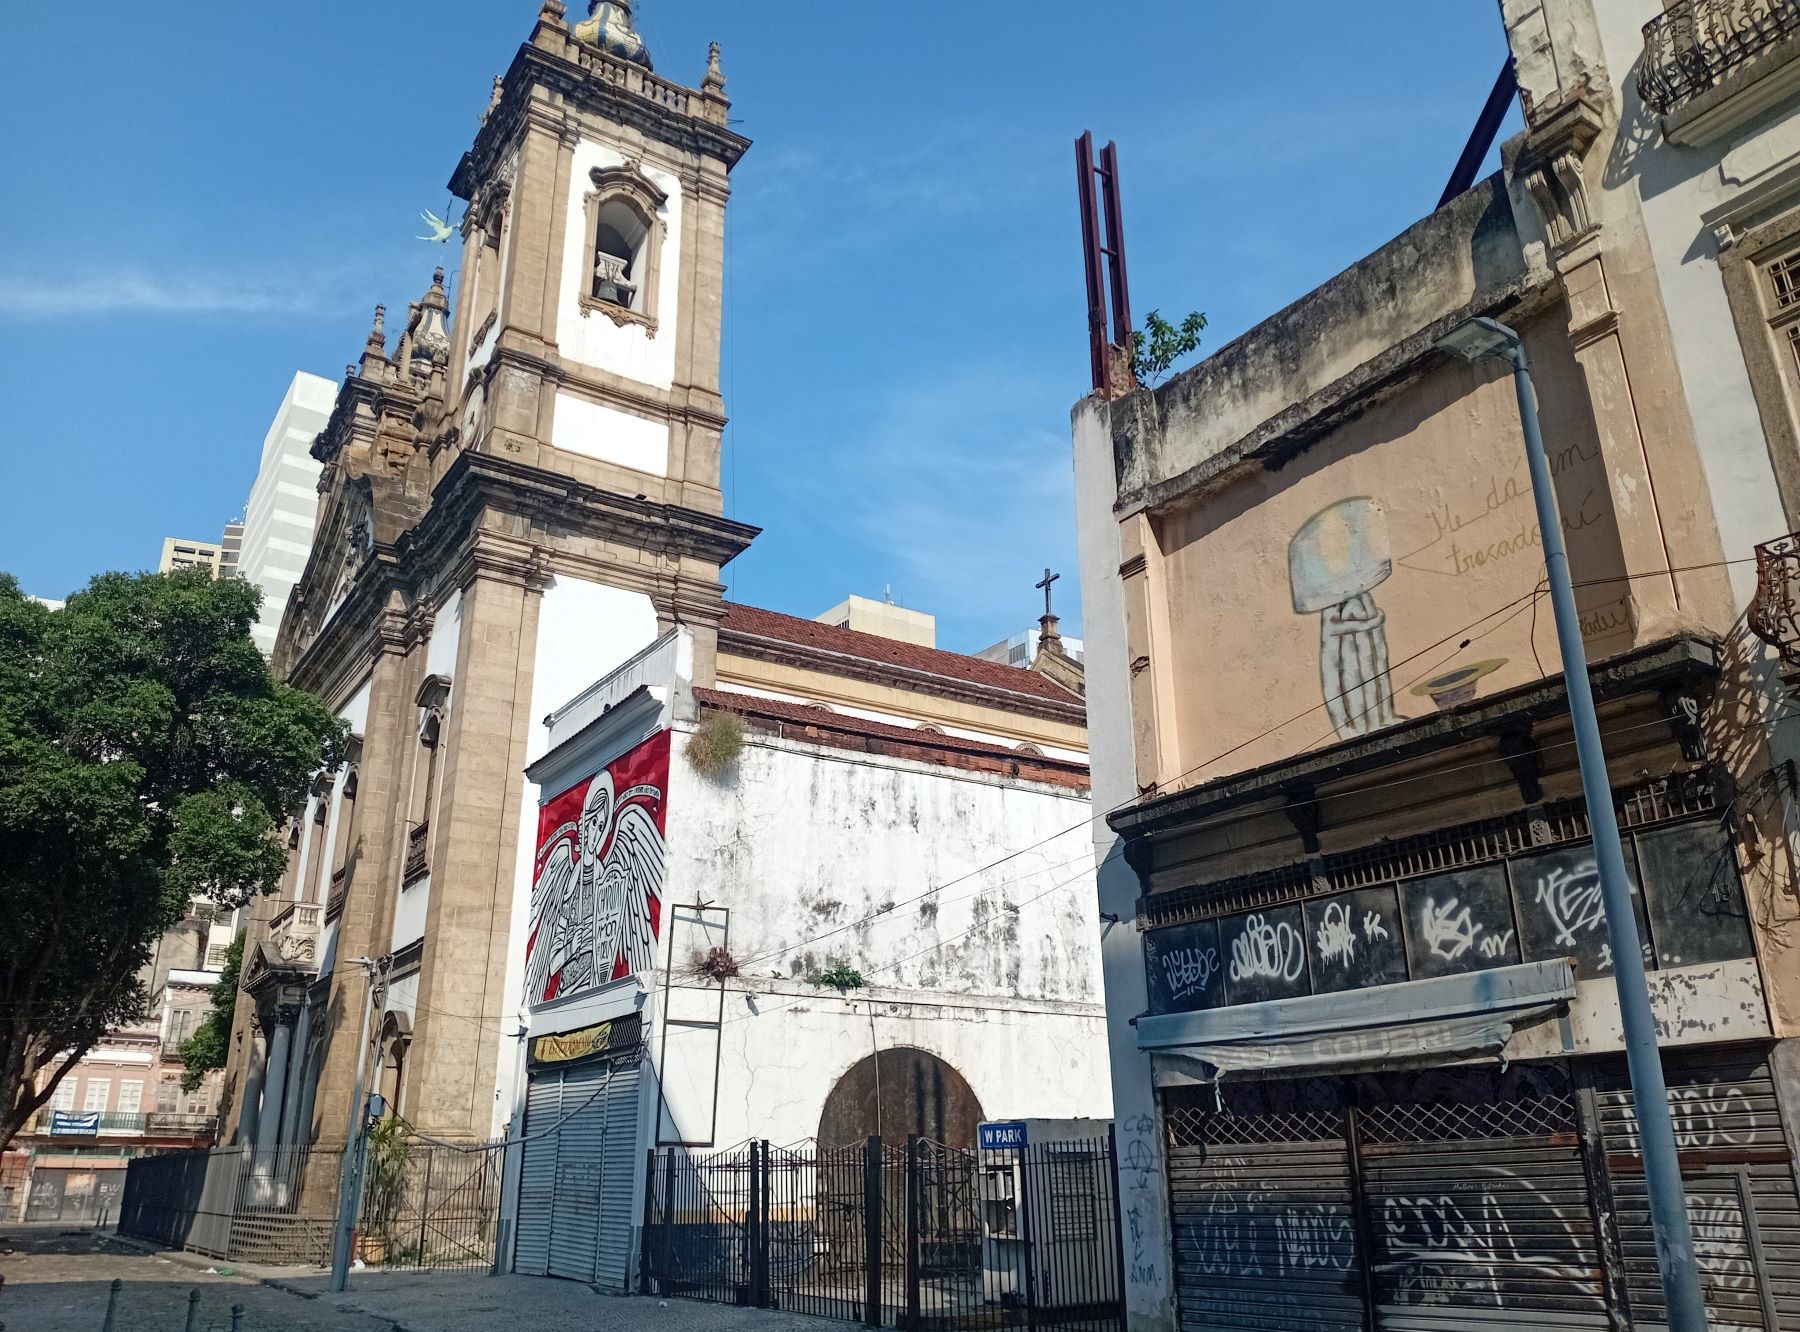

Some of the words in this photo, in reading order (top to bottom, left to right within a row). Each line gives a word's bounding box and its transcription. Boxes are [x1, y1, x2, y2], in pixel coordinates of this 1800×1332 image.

[1486, 455, 1522, 510] dá
[1312, 1023, 1454, 1059] COLIBRI
[984, 1129, 993, 1143] W
[995, 1129, 1022, 1144] PARK
